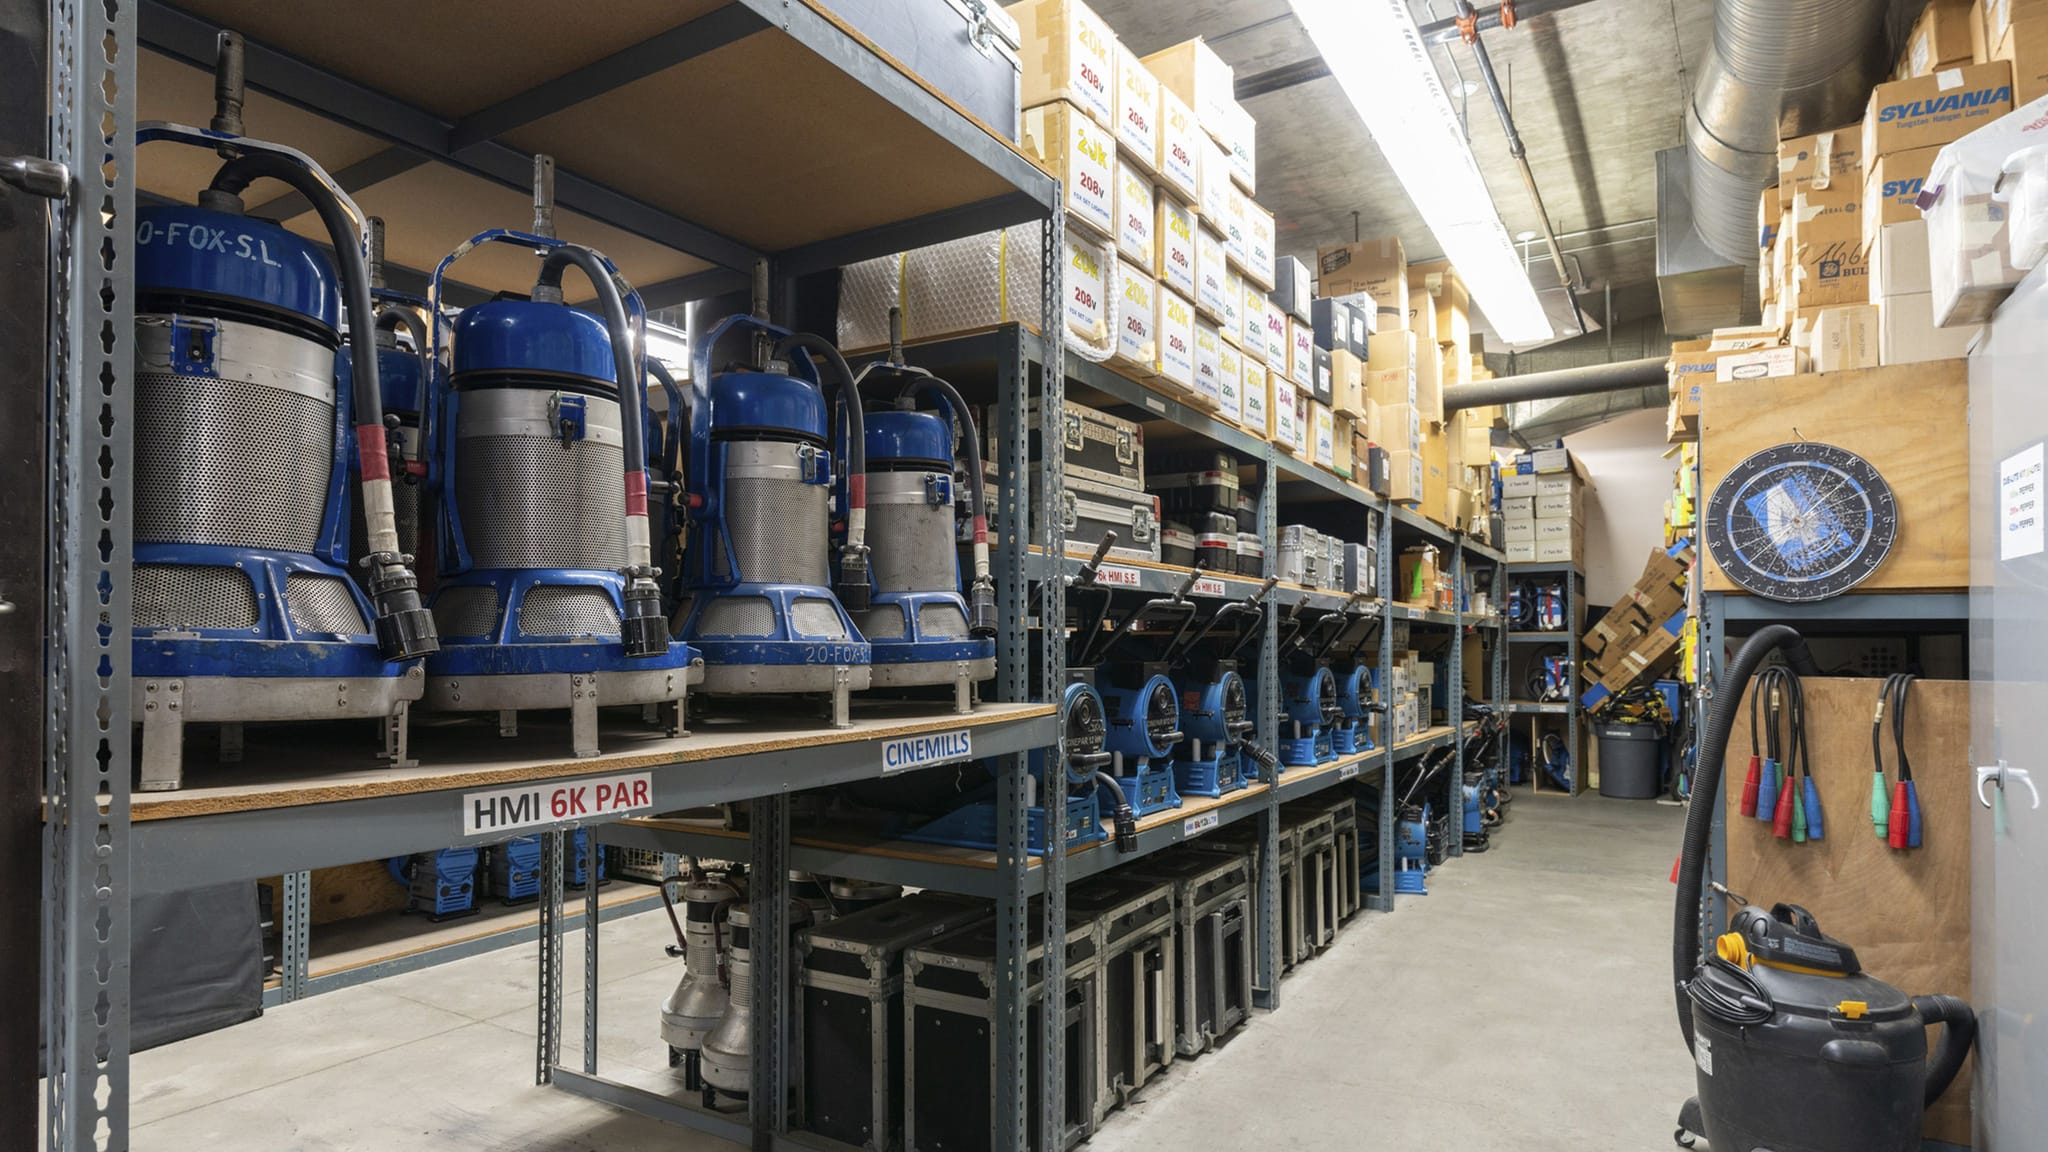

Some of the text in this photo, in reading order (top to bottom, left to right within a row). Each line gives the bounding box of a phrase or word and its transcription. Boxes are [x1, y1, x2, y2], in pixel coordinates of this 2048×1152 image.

[1879, 85, 2010, 123] SYLVANIA
[1109, 570, 1122, 583] HMI
[886, 732, 969, 766] CINEMILLS
[475, 780, 649, 829] HMI 6K PAR
